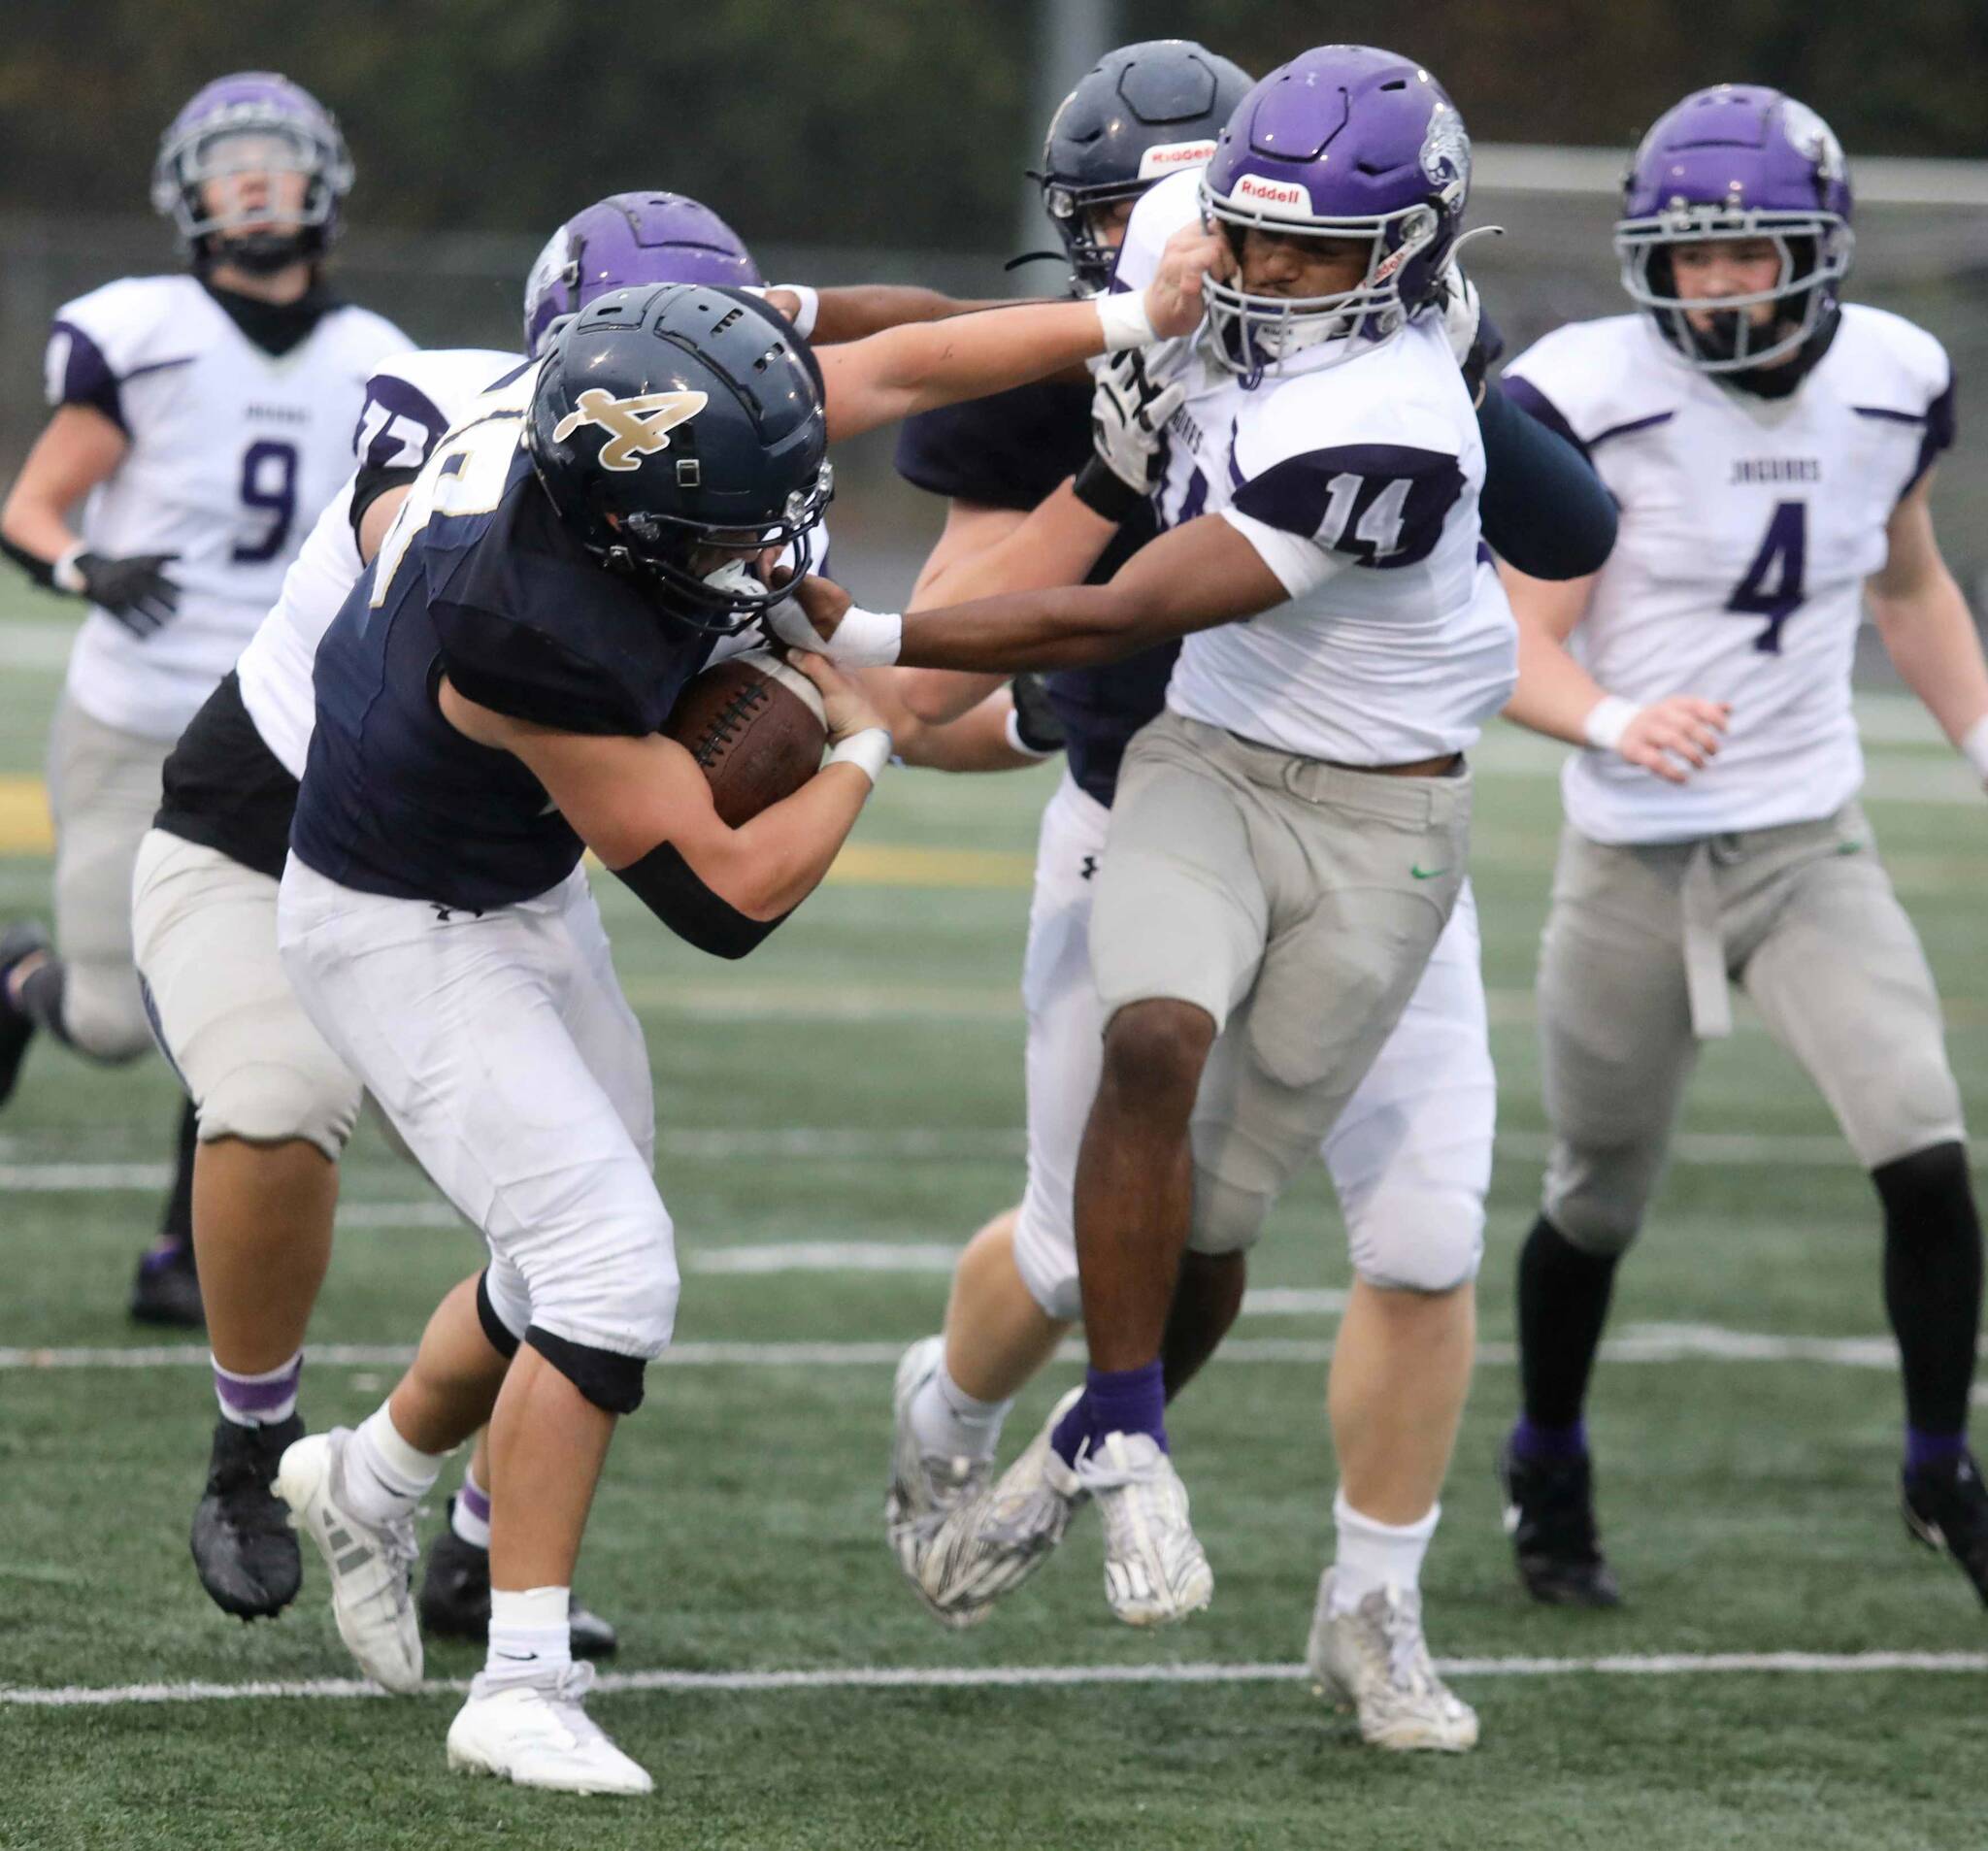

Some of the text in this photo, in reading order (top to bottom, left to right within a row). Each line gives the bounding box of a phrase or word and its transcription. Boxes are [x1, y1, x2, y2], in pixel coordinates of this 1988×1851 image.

[1242, 181, 1299, 204] Riddell
[232, 442, 298, 561] 9
[1311, 472, 1413, 557] 14
[1723, 501, 1807, 656] 4
